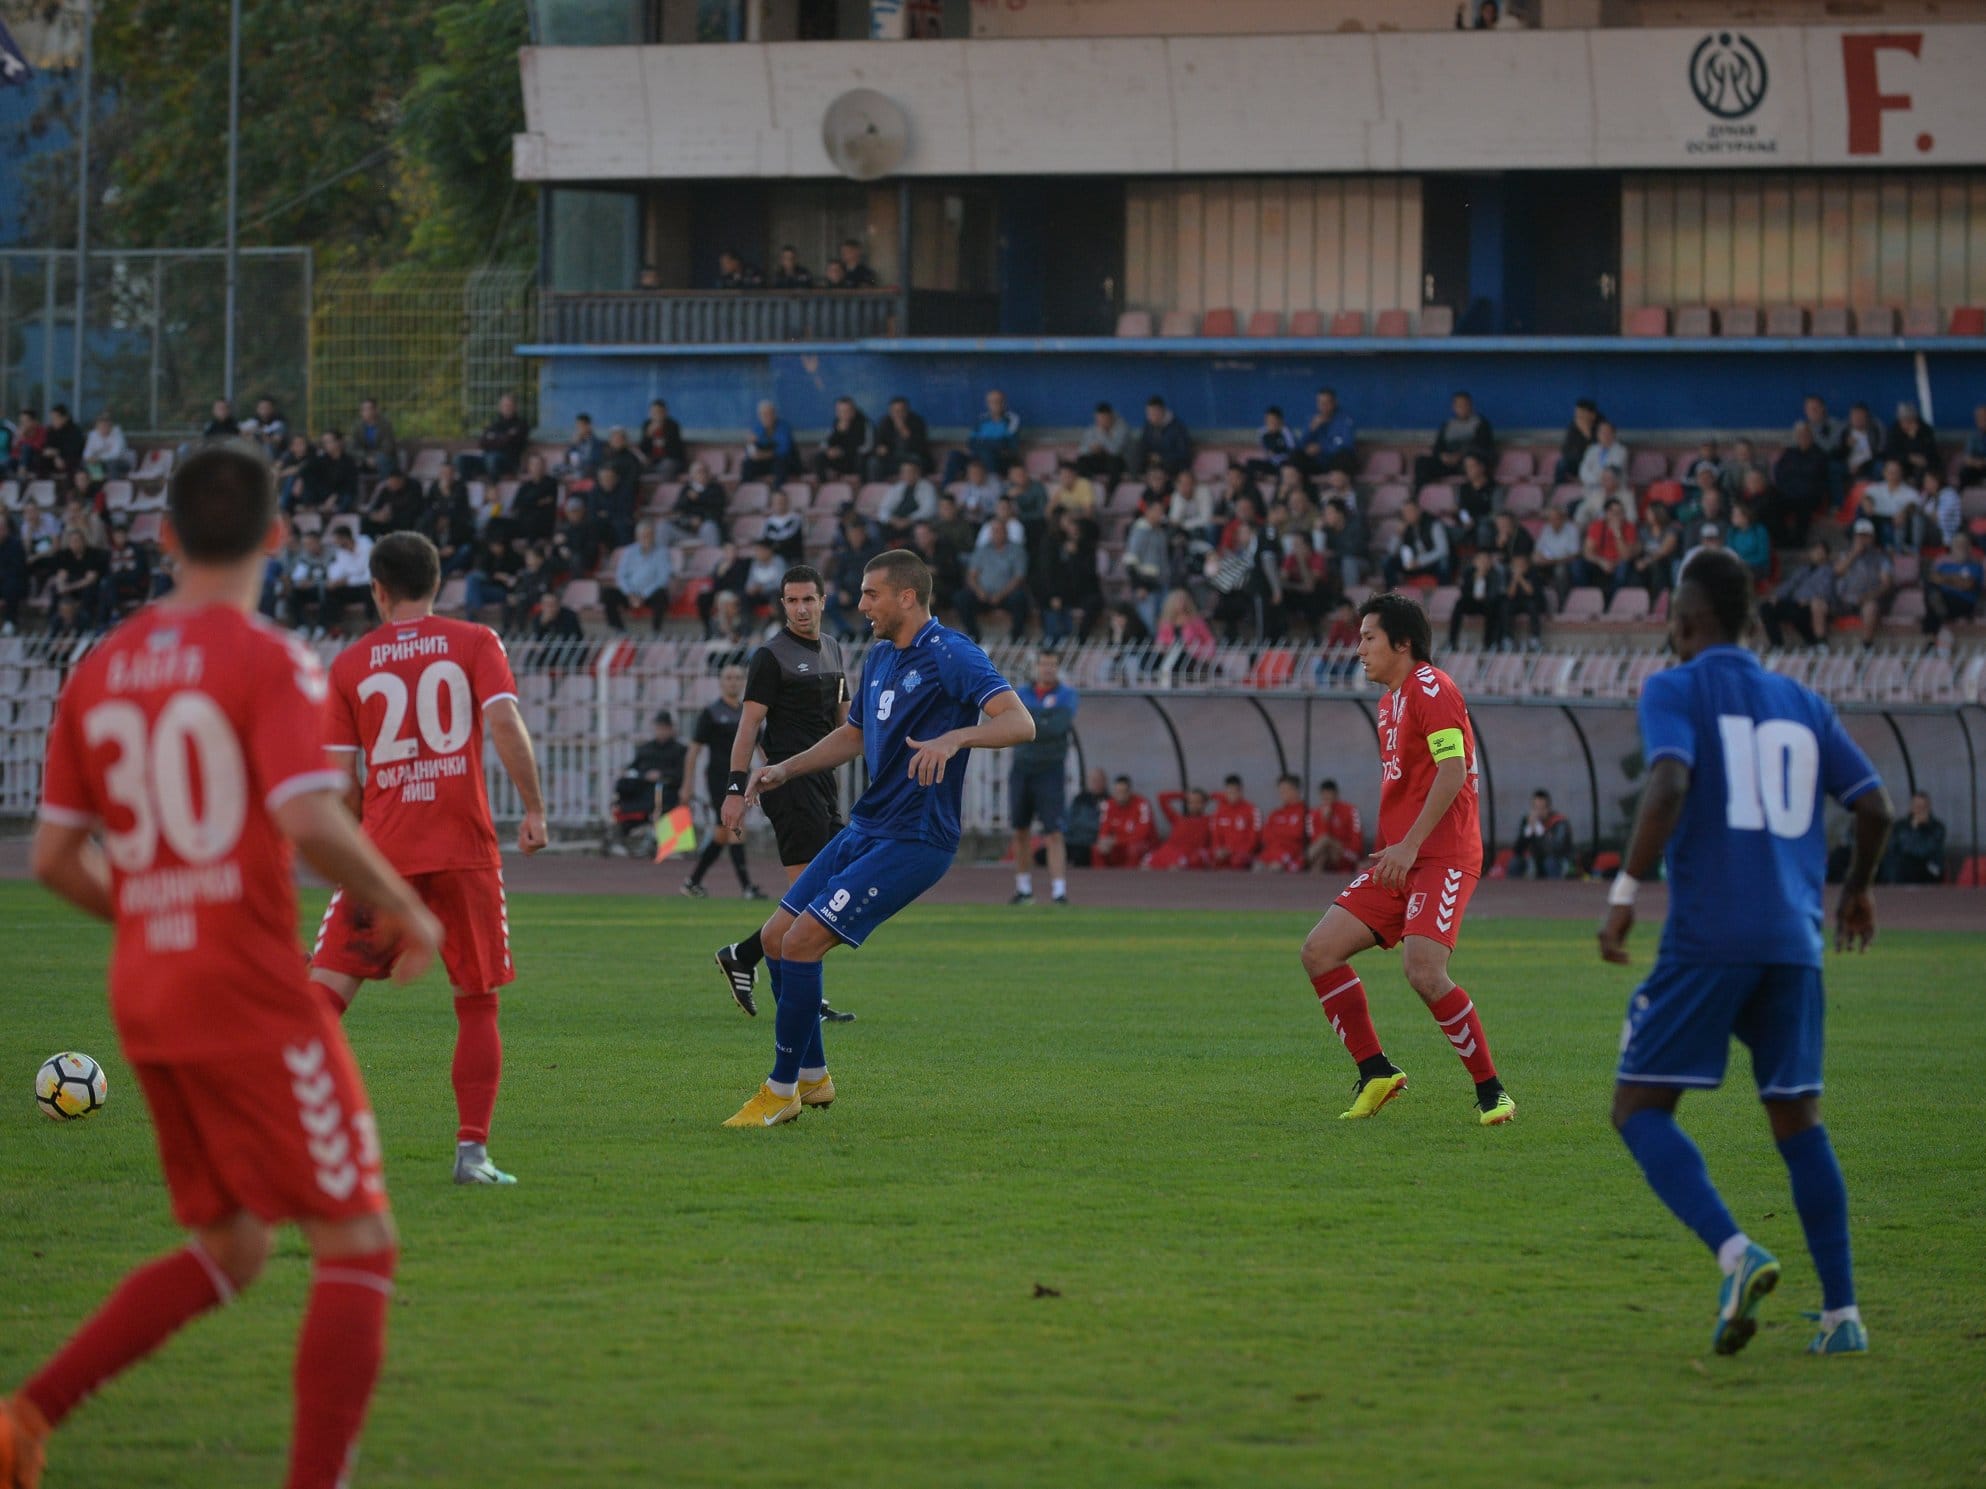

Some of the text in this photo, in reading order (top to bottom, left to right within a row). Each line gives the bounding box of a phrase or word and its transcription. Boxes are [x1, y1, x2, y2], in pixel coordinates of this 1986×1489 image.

[370, 636, 449, 668] ДРИНЧИЋ
[357, 660, 473, 766] 20
[877, 689, 895, 721] 9
[1432, 744, 1456, 756] ummel
[83, 690, 248, 873] 30
[401, 781, 435, 804] НИШ
[1718, 714, 1819, 839] 10
[820, 906, 838, 922] JAKO
[828, 888, 851, 912] 9
